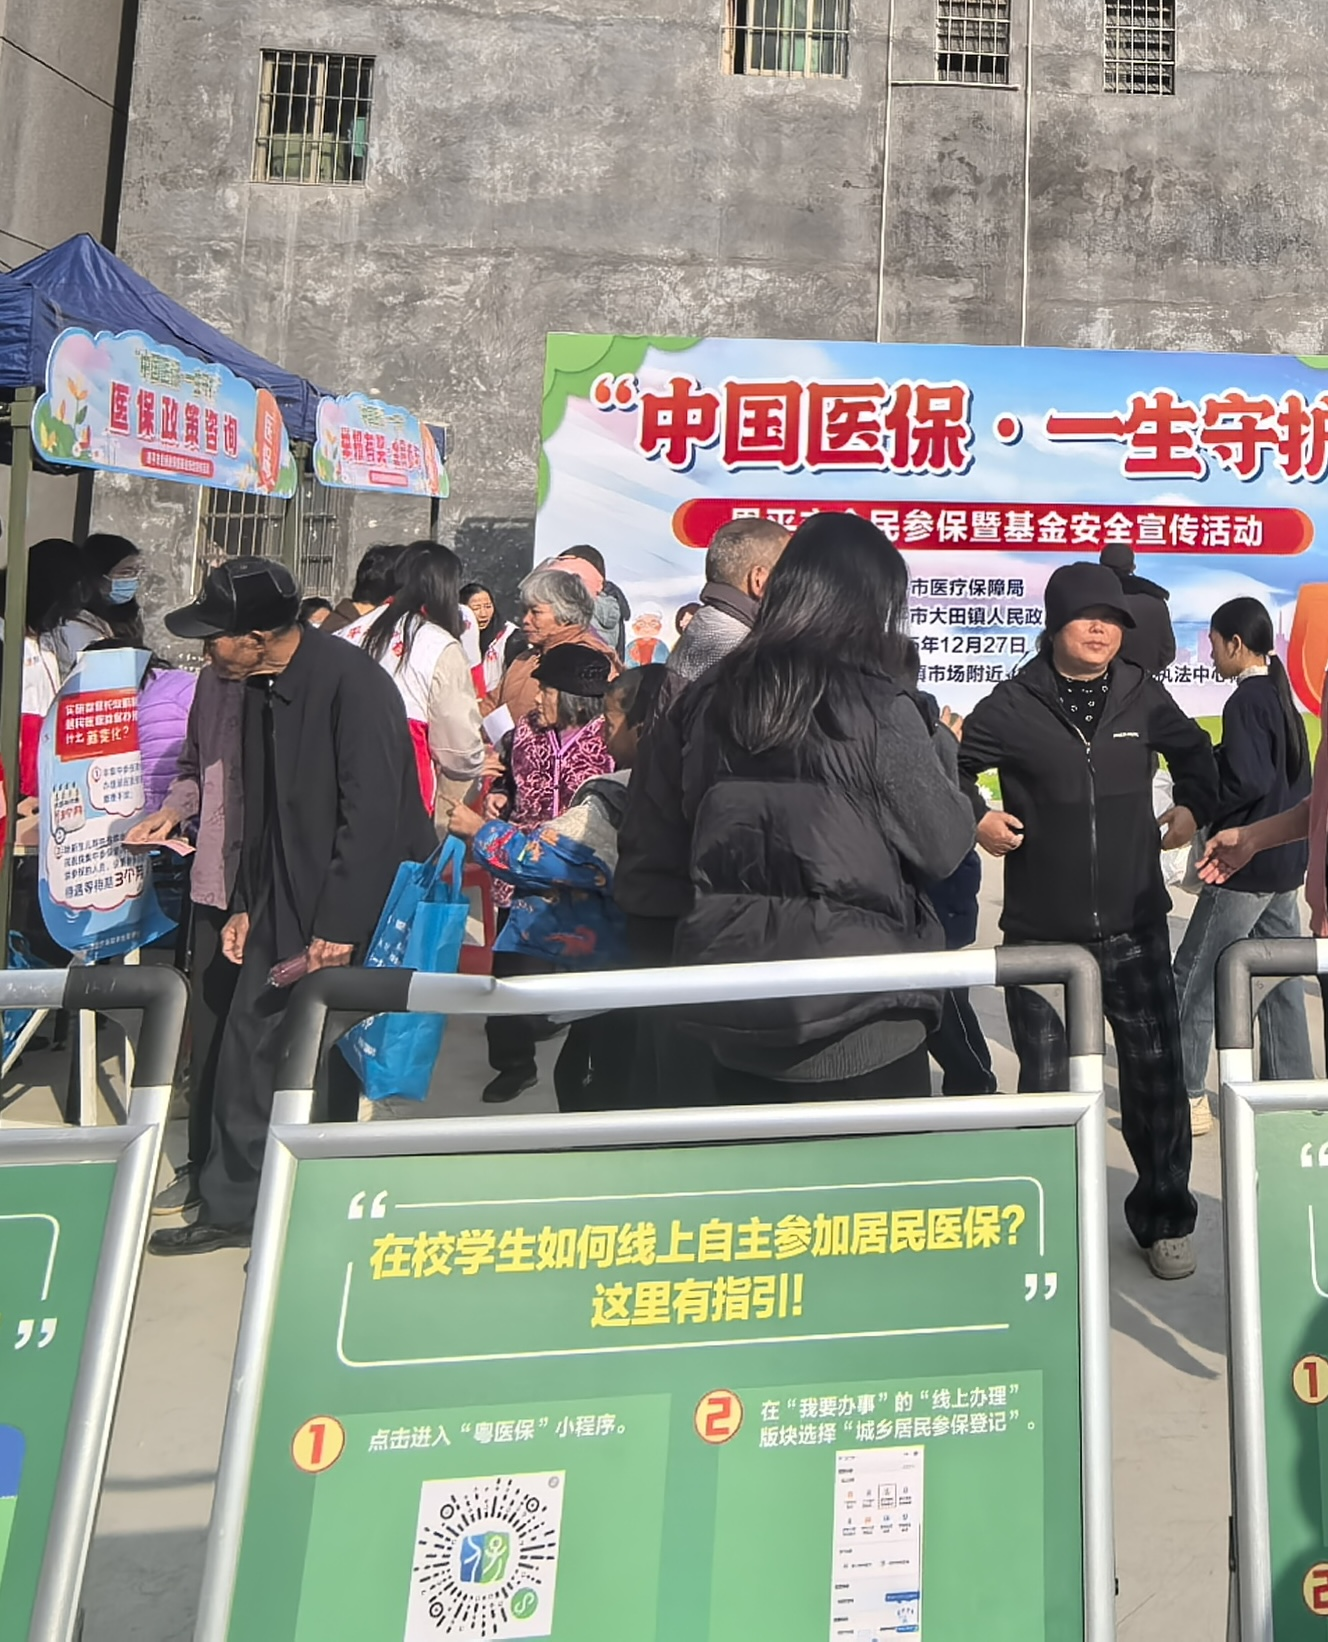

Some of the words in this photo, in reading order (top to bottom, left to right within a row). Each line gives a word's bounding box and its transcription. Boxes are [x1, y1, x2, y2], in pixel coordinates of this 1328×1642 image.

[109, 381, 238, 457] 医保政策咨询
[731, 506, 1264, 549] 平民参保暨基金安全宣传活动
[910, 578, 1024, 597] 市医疗保障局
[909, 607, 1043, 625] 市大田镇人民政
[370, 1203, 1026, 1279] 在校学生如何线上自主参加居民医保?
[591, 1273, 804, 1329] 这里有指引!
[1303, 1361, 1319, 1398] 1
[713, 1396, 735, 1438] 2
[305, 1422, 328, 1464] 1
